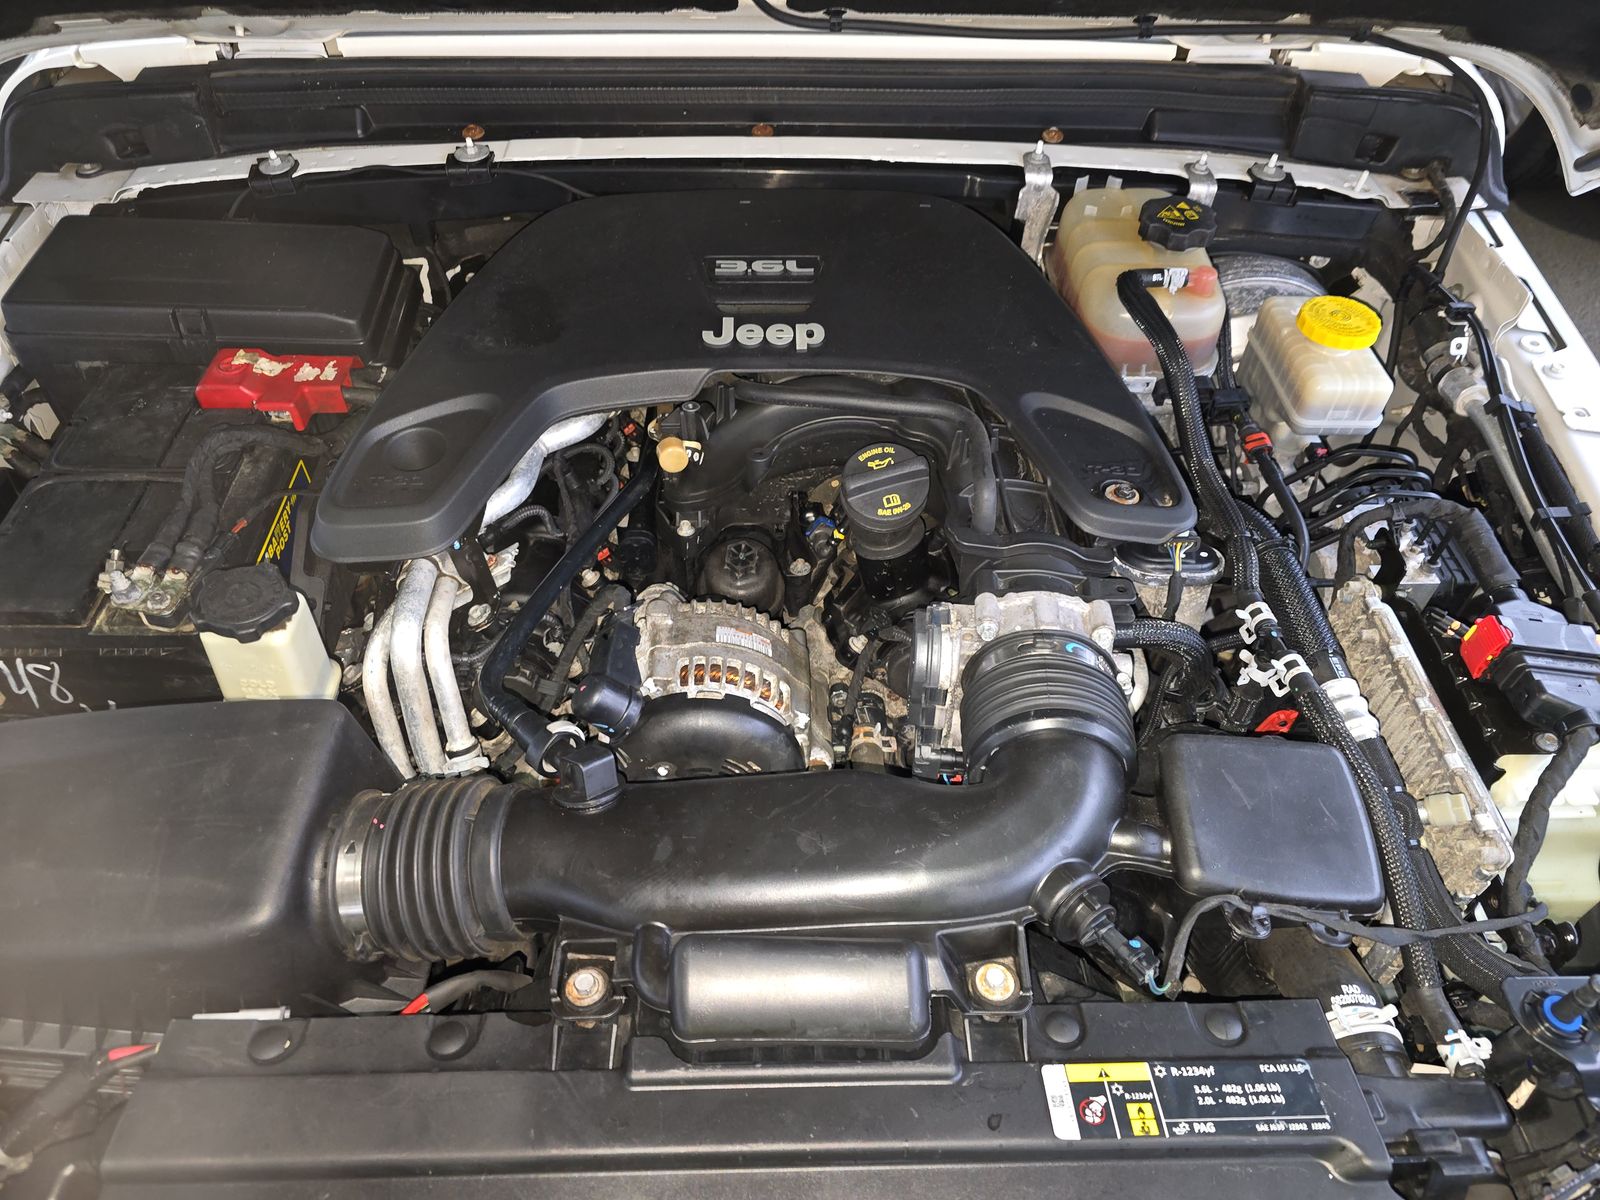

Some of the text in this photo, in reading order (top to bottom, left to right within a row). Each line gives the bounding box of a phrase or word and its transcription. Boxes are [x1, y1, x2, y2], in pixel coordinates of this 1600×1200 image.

[714, 259, 814, 276] 3.6L
[702, 316, 825, 352] Jeep
[858, 447, 883, 462] ENGINE
[276, 520, 291, 560] POST
[1341, 984, 1361, 994] RAD
[1170, 1065, 1215, 1077] R-1234yf
[1259, 1064, 1277, 1073] FCA
[1278, 1064, 1289, 1072] US
[1197, 1096, 1216, 1105] 2.0L
[1193, 1122, 1216, 1133] PAG
